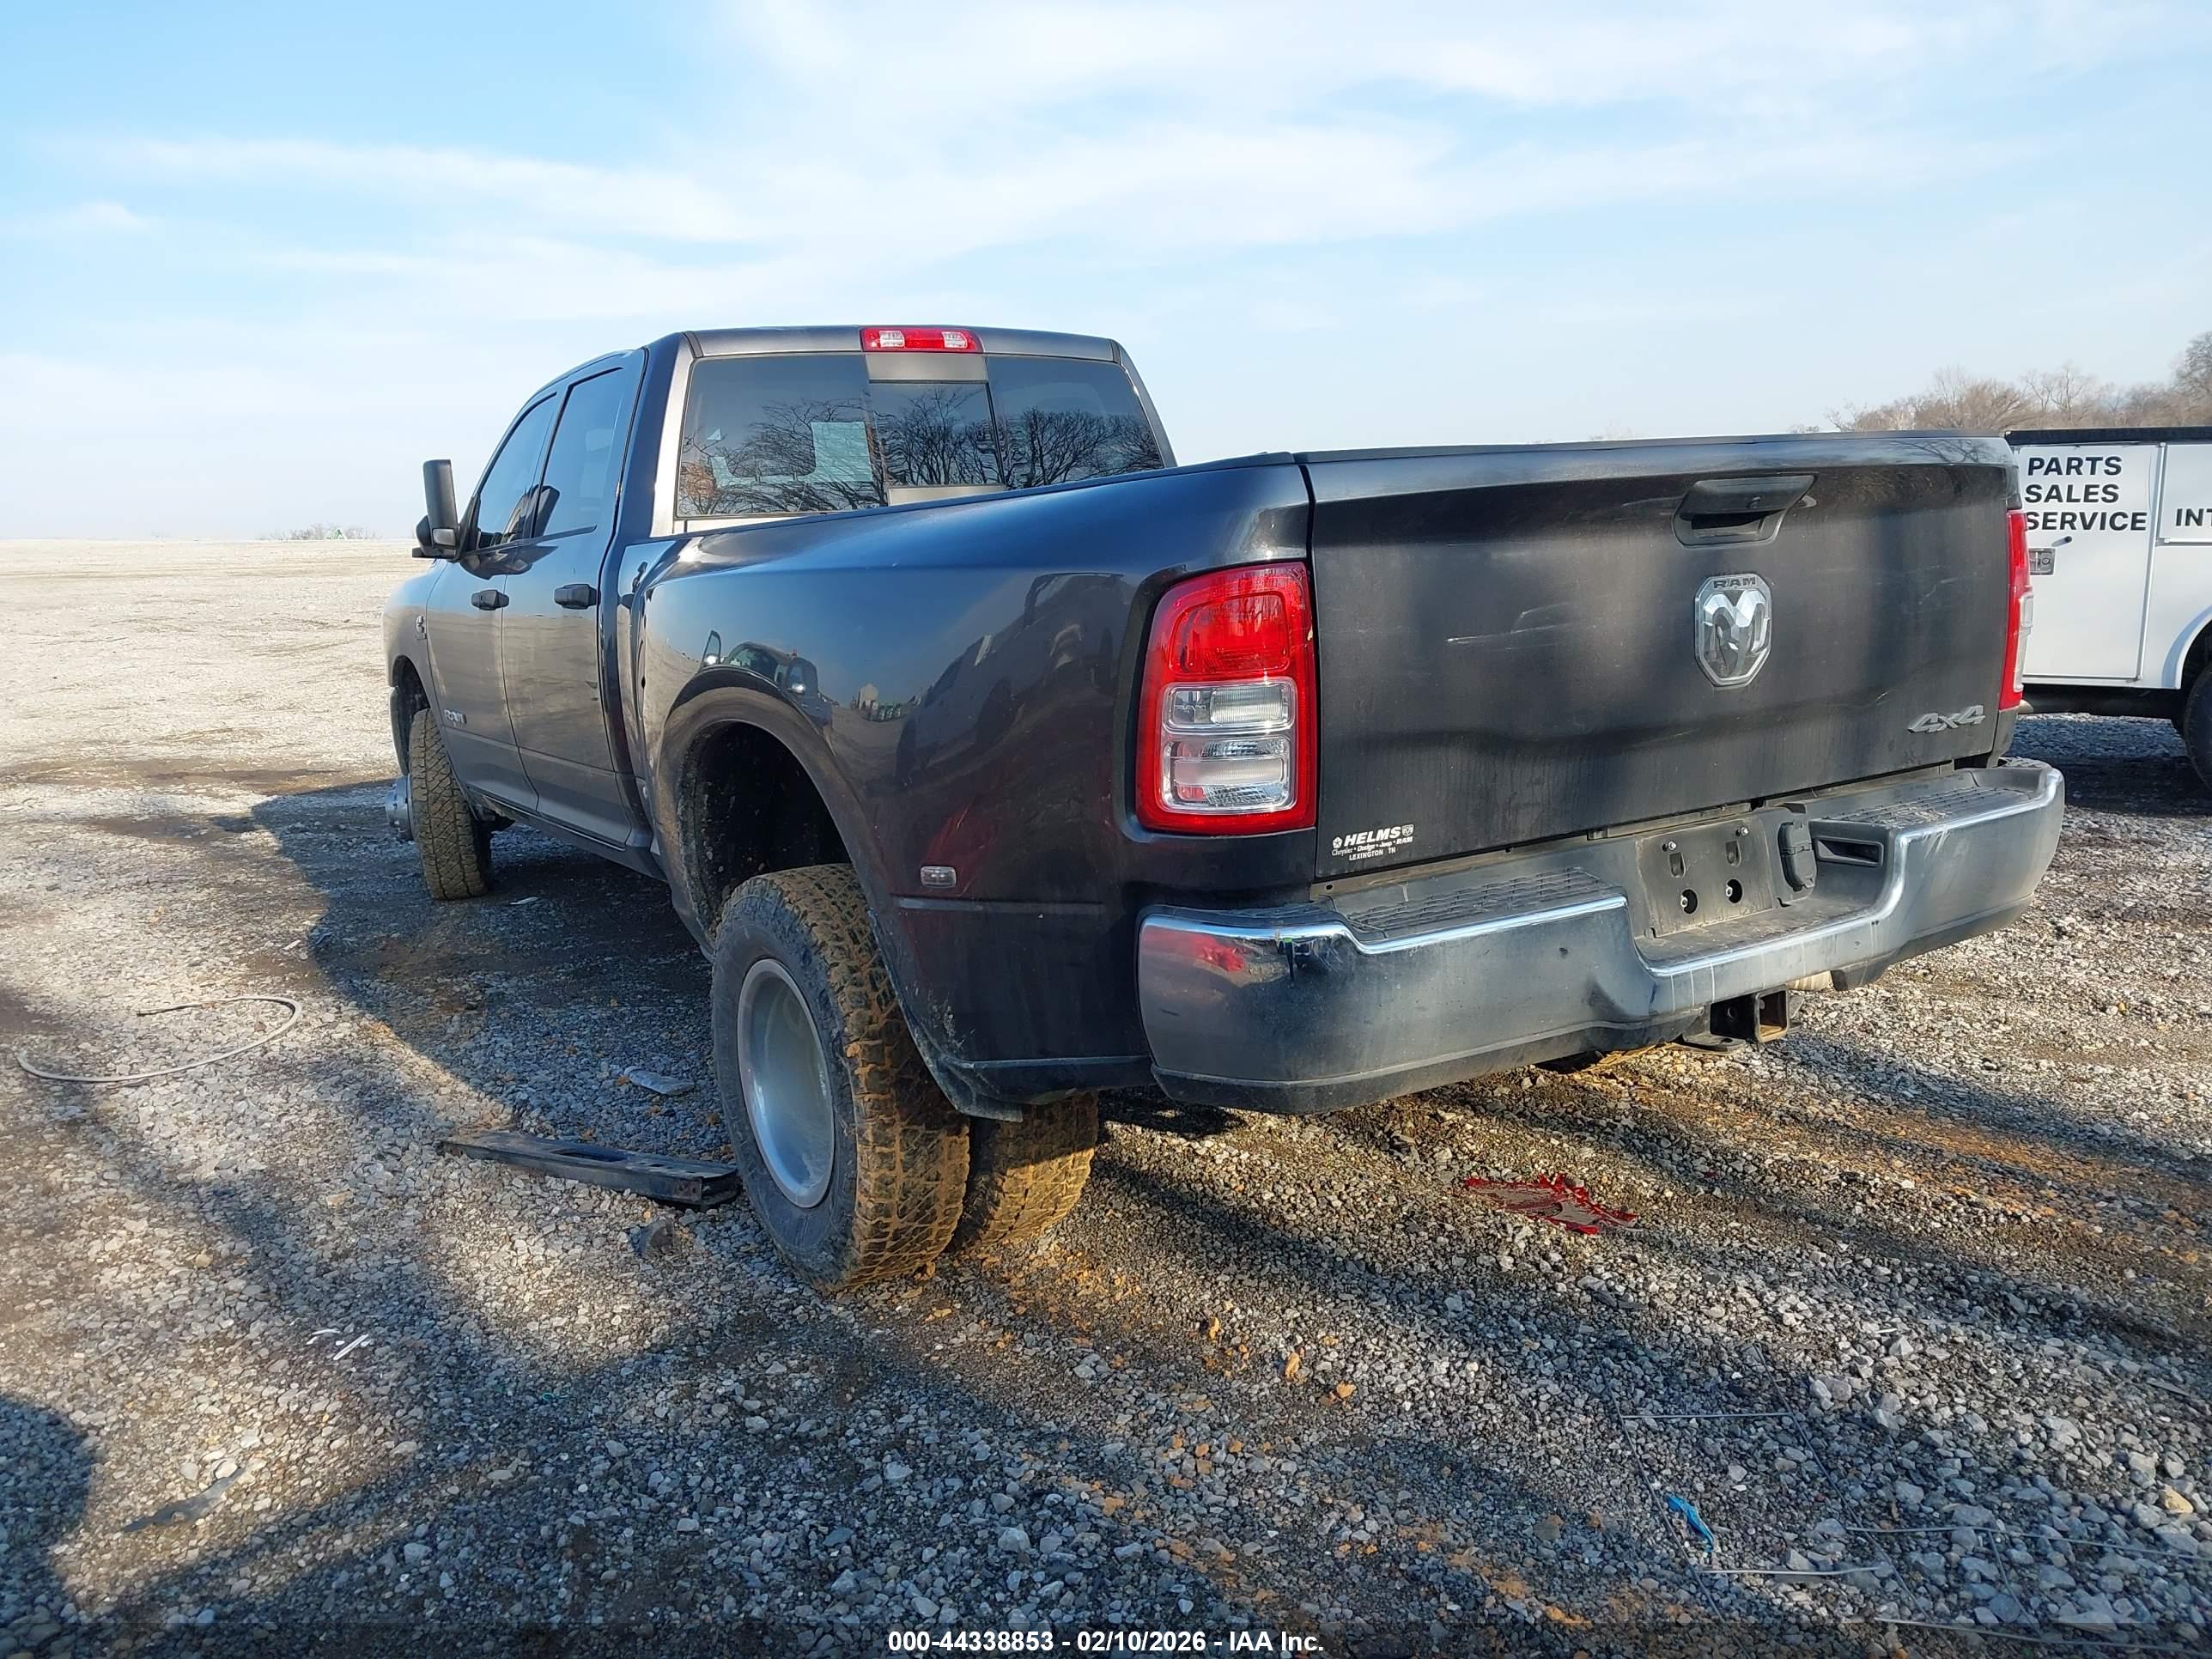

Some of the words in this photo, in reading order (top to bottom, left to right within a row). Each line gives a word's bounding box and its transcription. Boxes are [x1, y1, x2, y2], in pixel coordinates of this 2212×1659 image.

[2027, 456, 2123, 476] PARTS
[2025, 484, 2119, 503] SALES
[2027, 512, 2147, 531] SERVICE
[1713, 577, 1756, 588] RAM
[1344, 826, 1401, 847] HELMS
[1349, 849, 1383, 860] LEXINGTON
